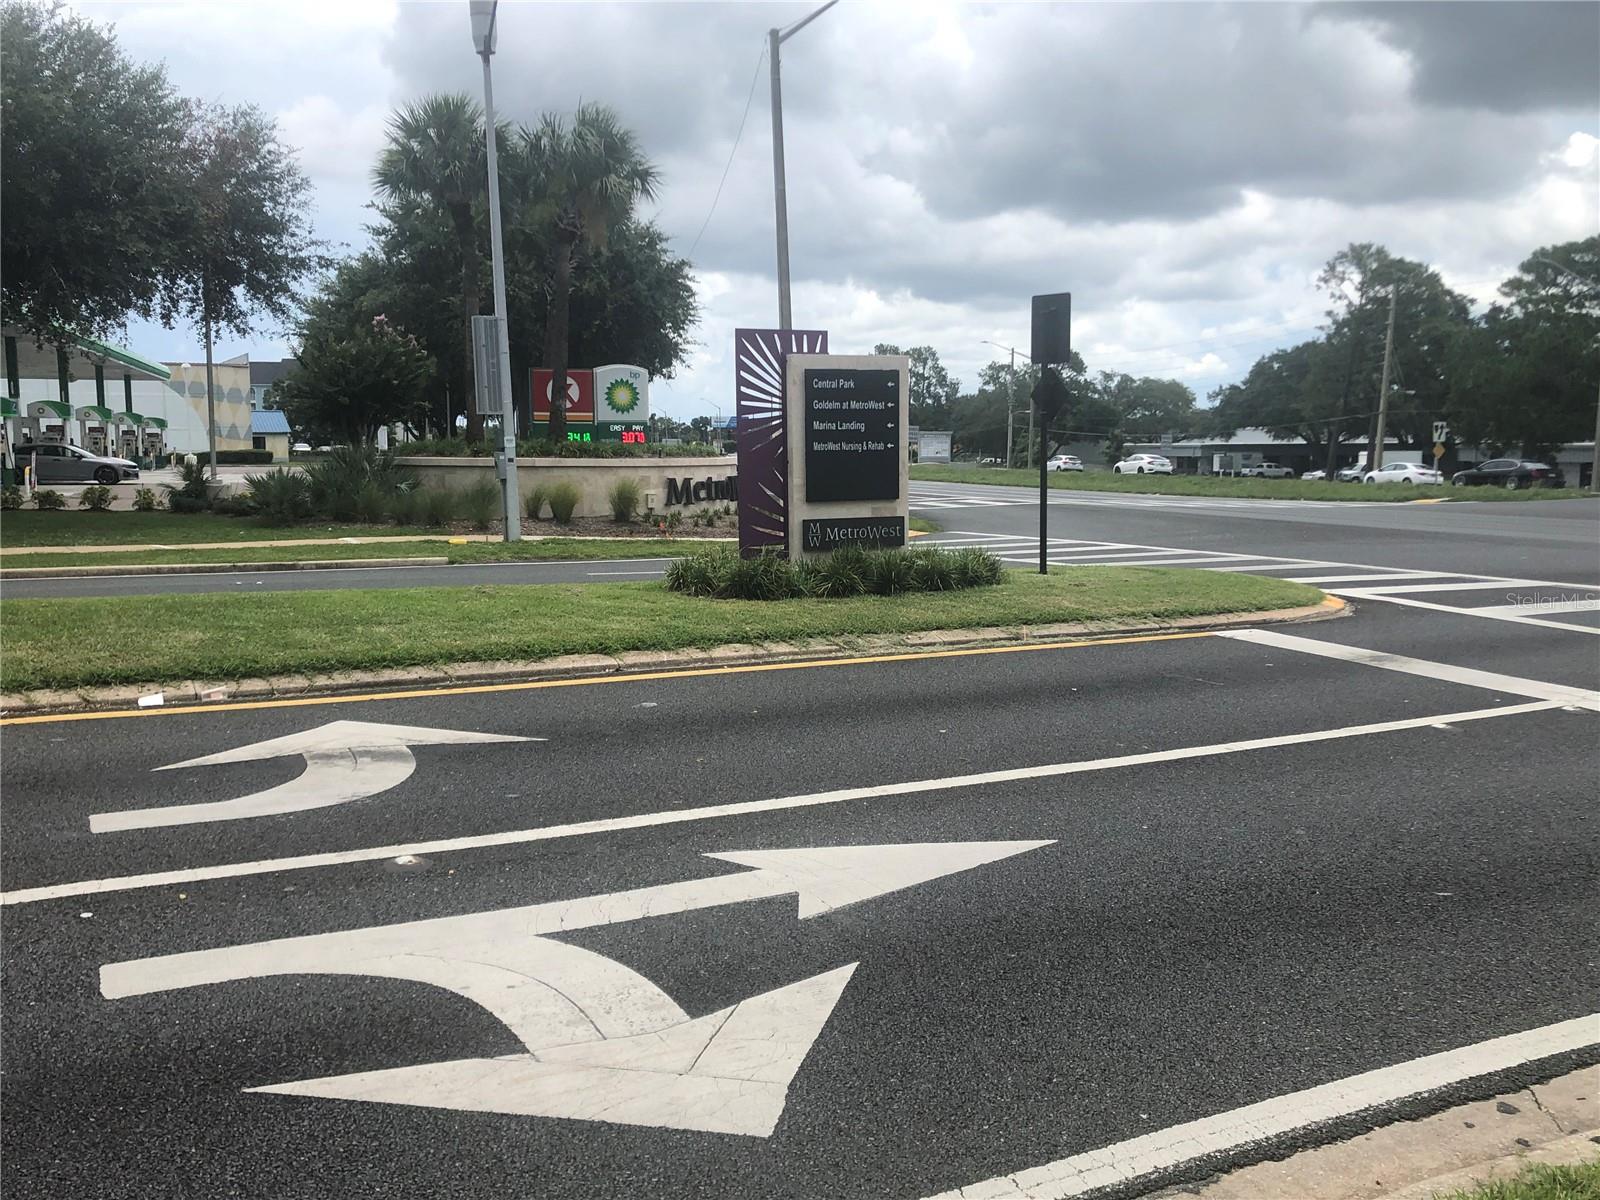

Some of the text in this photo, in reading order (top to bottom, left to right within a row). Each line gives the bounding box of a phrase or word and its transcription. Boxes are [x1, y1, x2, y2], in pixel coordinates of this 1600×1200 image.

[629, 370, 641, 381] bp
[812, 378, 855, 389] Central Park
[812, 399, 885, 410] Goldelm at MetroWest
[609, 424, 645, 432] EASY PAY
[812, 420, 865, 433] Marina Landing
[813, 441, 885, 453] MetroWest Nursing & Rehab
[825, 525, 902, 541] MetroWest
